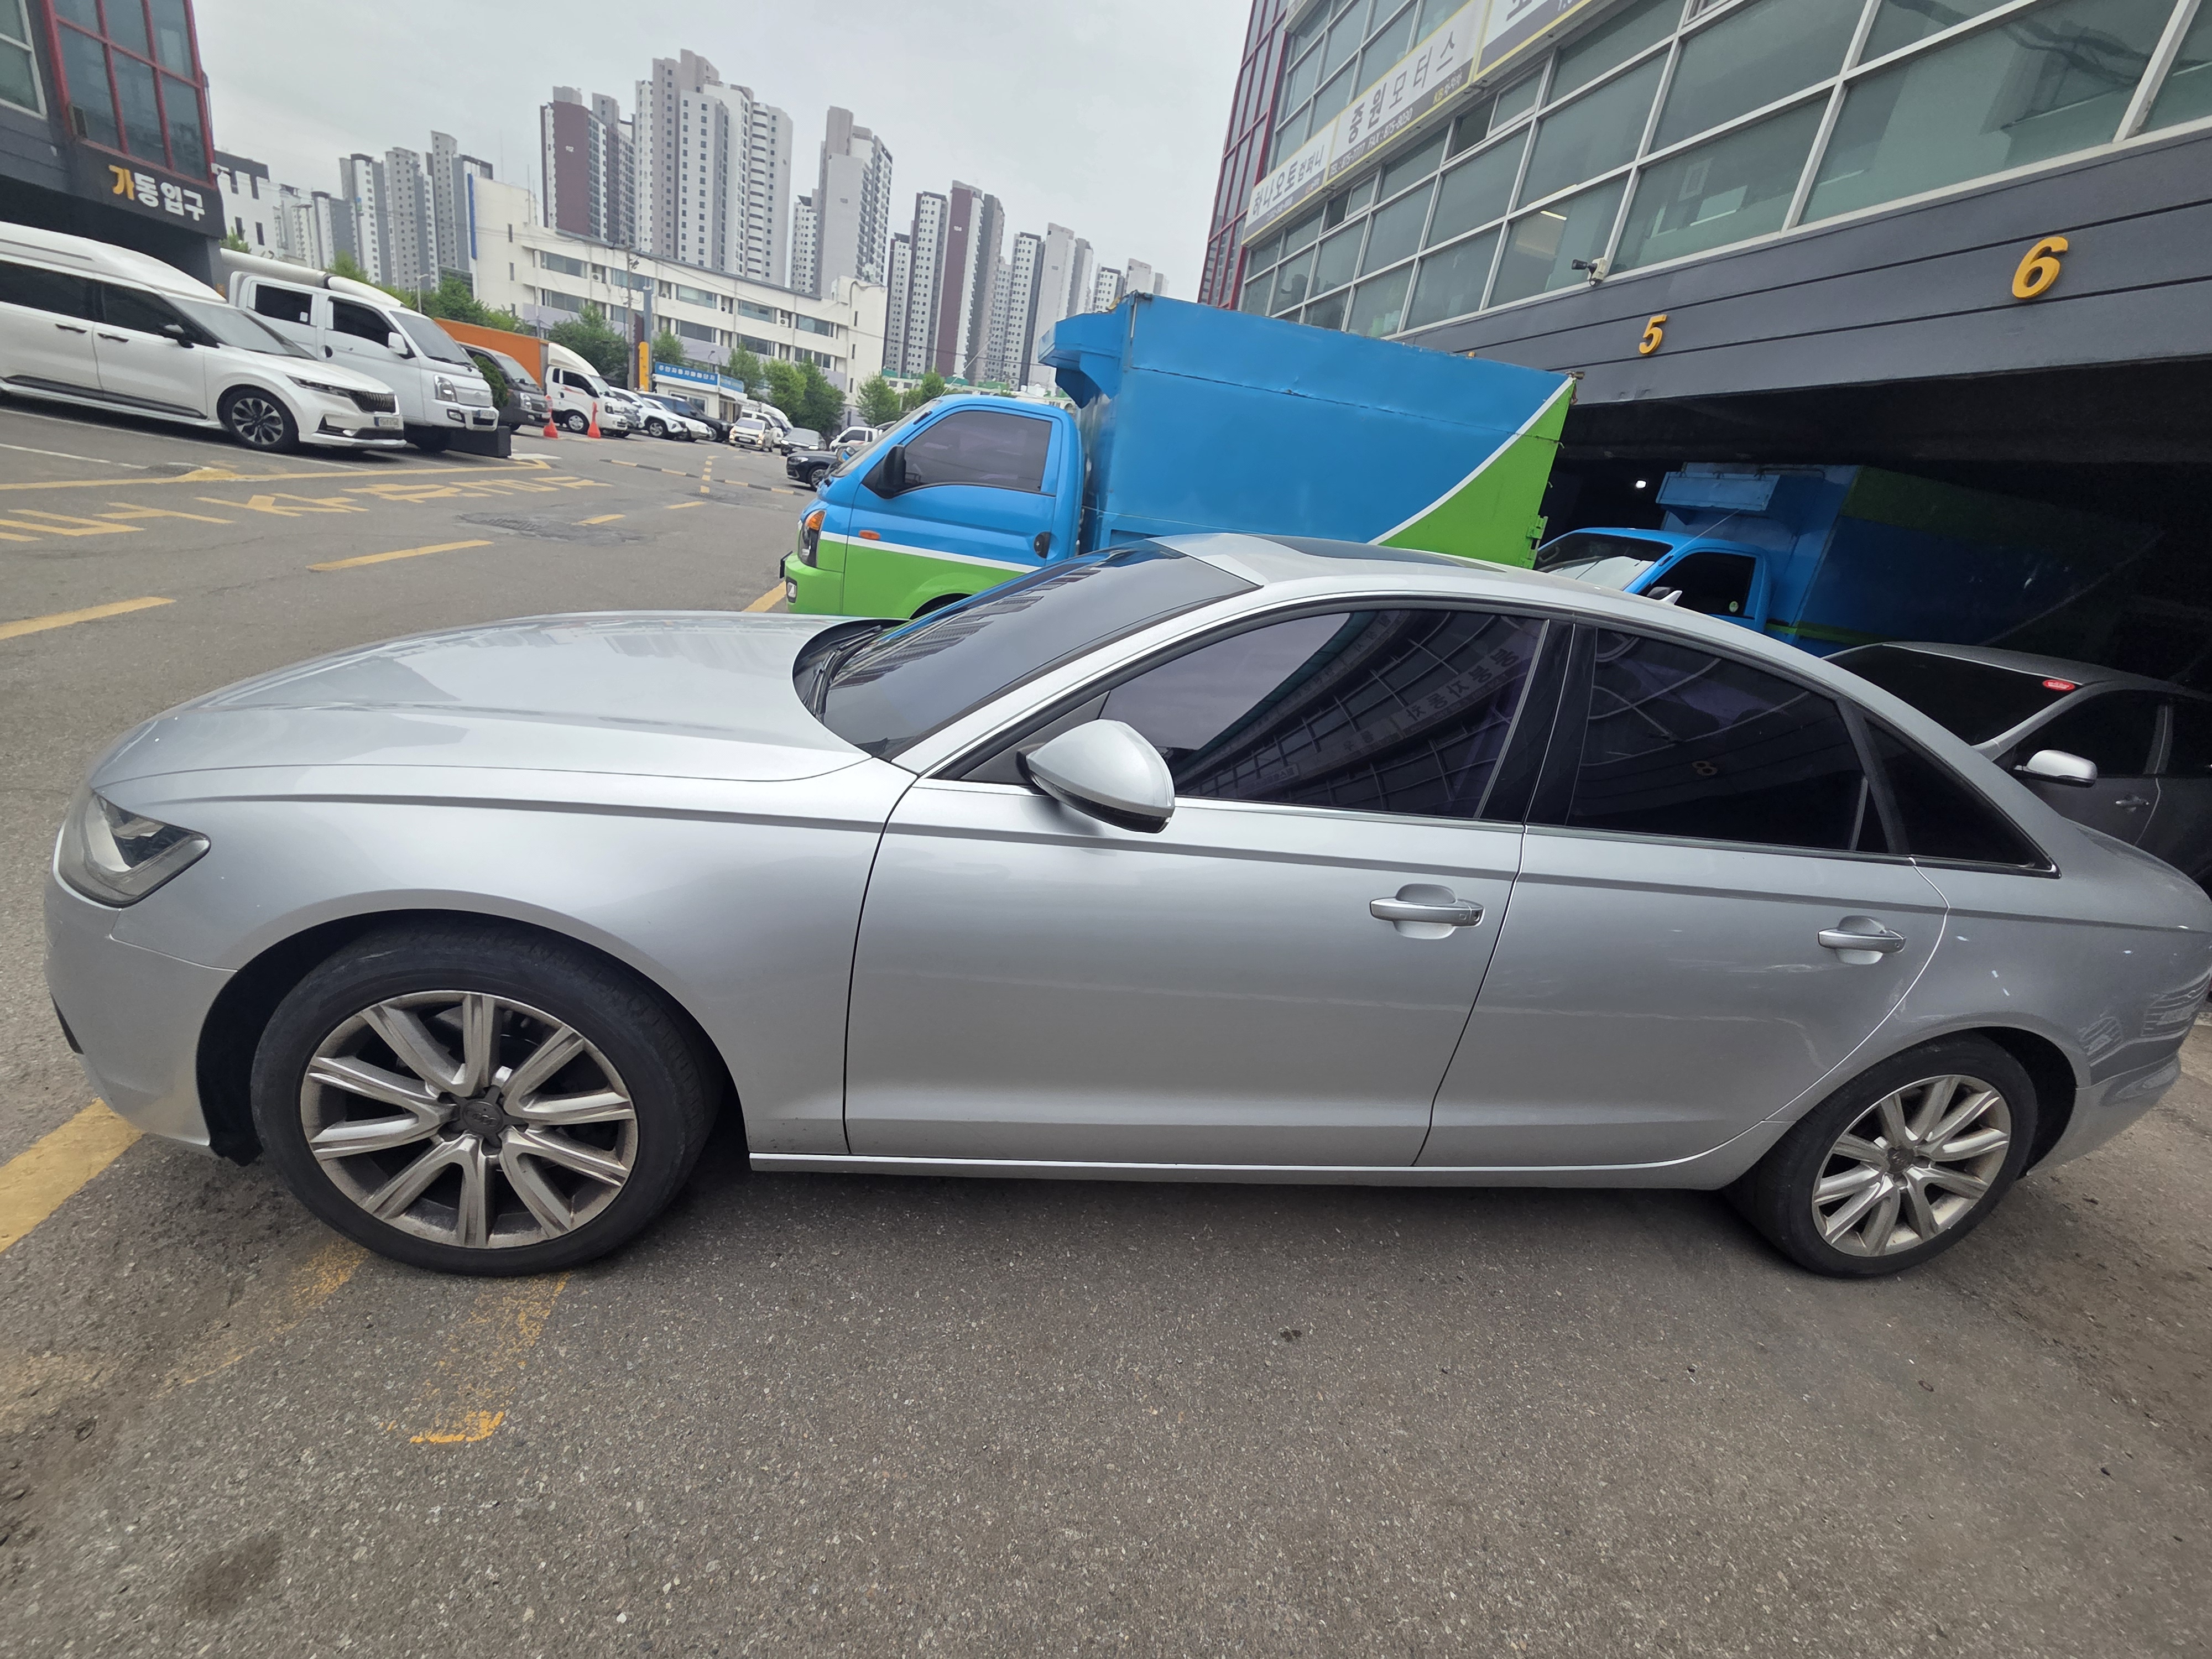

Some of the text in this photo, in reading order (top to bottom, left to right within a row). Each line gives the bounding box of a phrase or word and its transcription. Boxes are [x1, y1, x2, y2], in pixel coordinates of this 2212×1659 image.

[1348, 30, 1455, 144] 중원모터스
[2012, 236, 2068, 299] 6
[1639, 314, 1667, 354] 5
